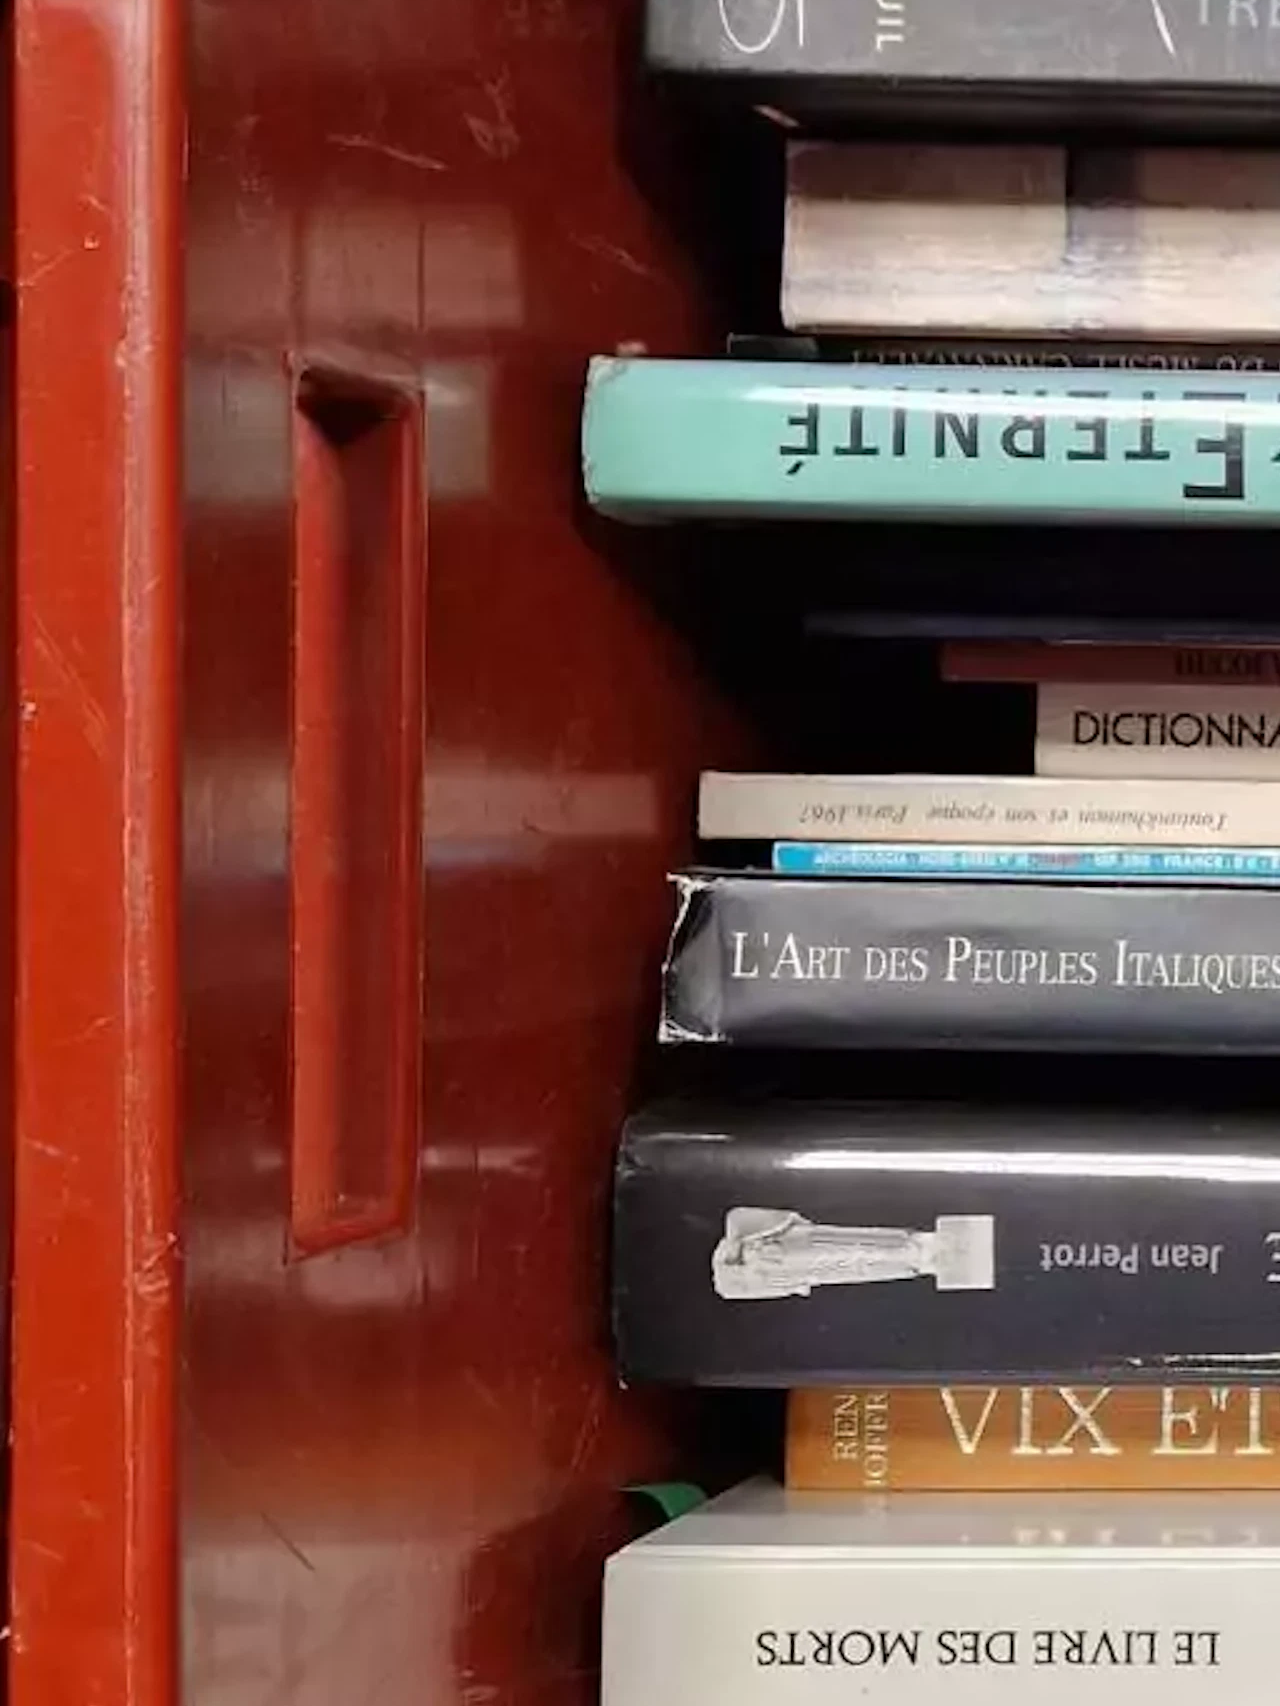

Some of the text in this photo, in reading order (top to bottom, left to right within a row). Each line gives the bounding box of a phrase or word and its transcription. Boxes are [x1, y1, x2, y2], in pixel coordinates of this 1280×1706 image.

[1039, 1241, 1226, 1275] Jean Perrot
[938, 1387, 1125, 1455] VIX
[755, 1630, 1221, 1666] LE LIVRE DES MORTS
